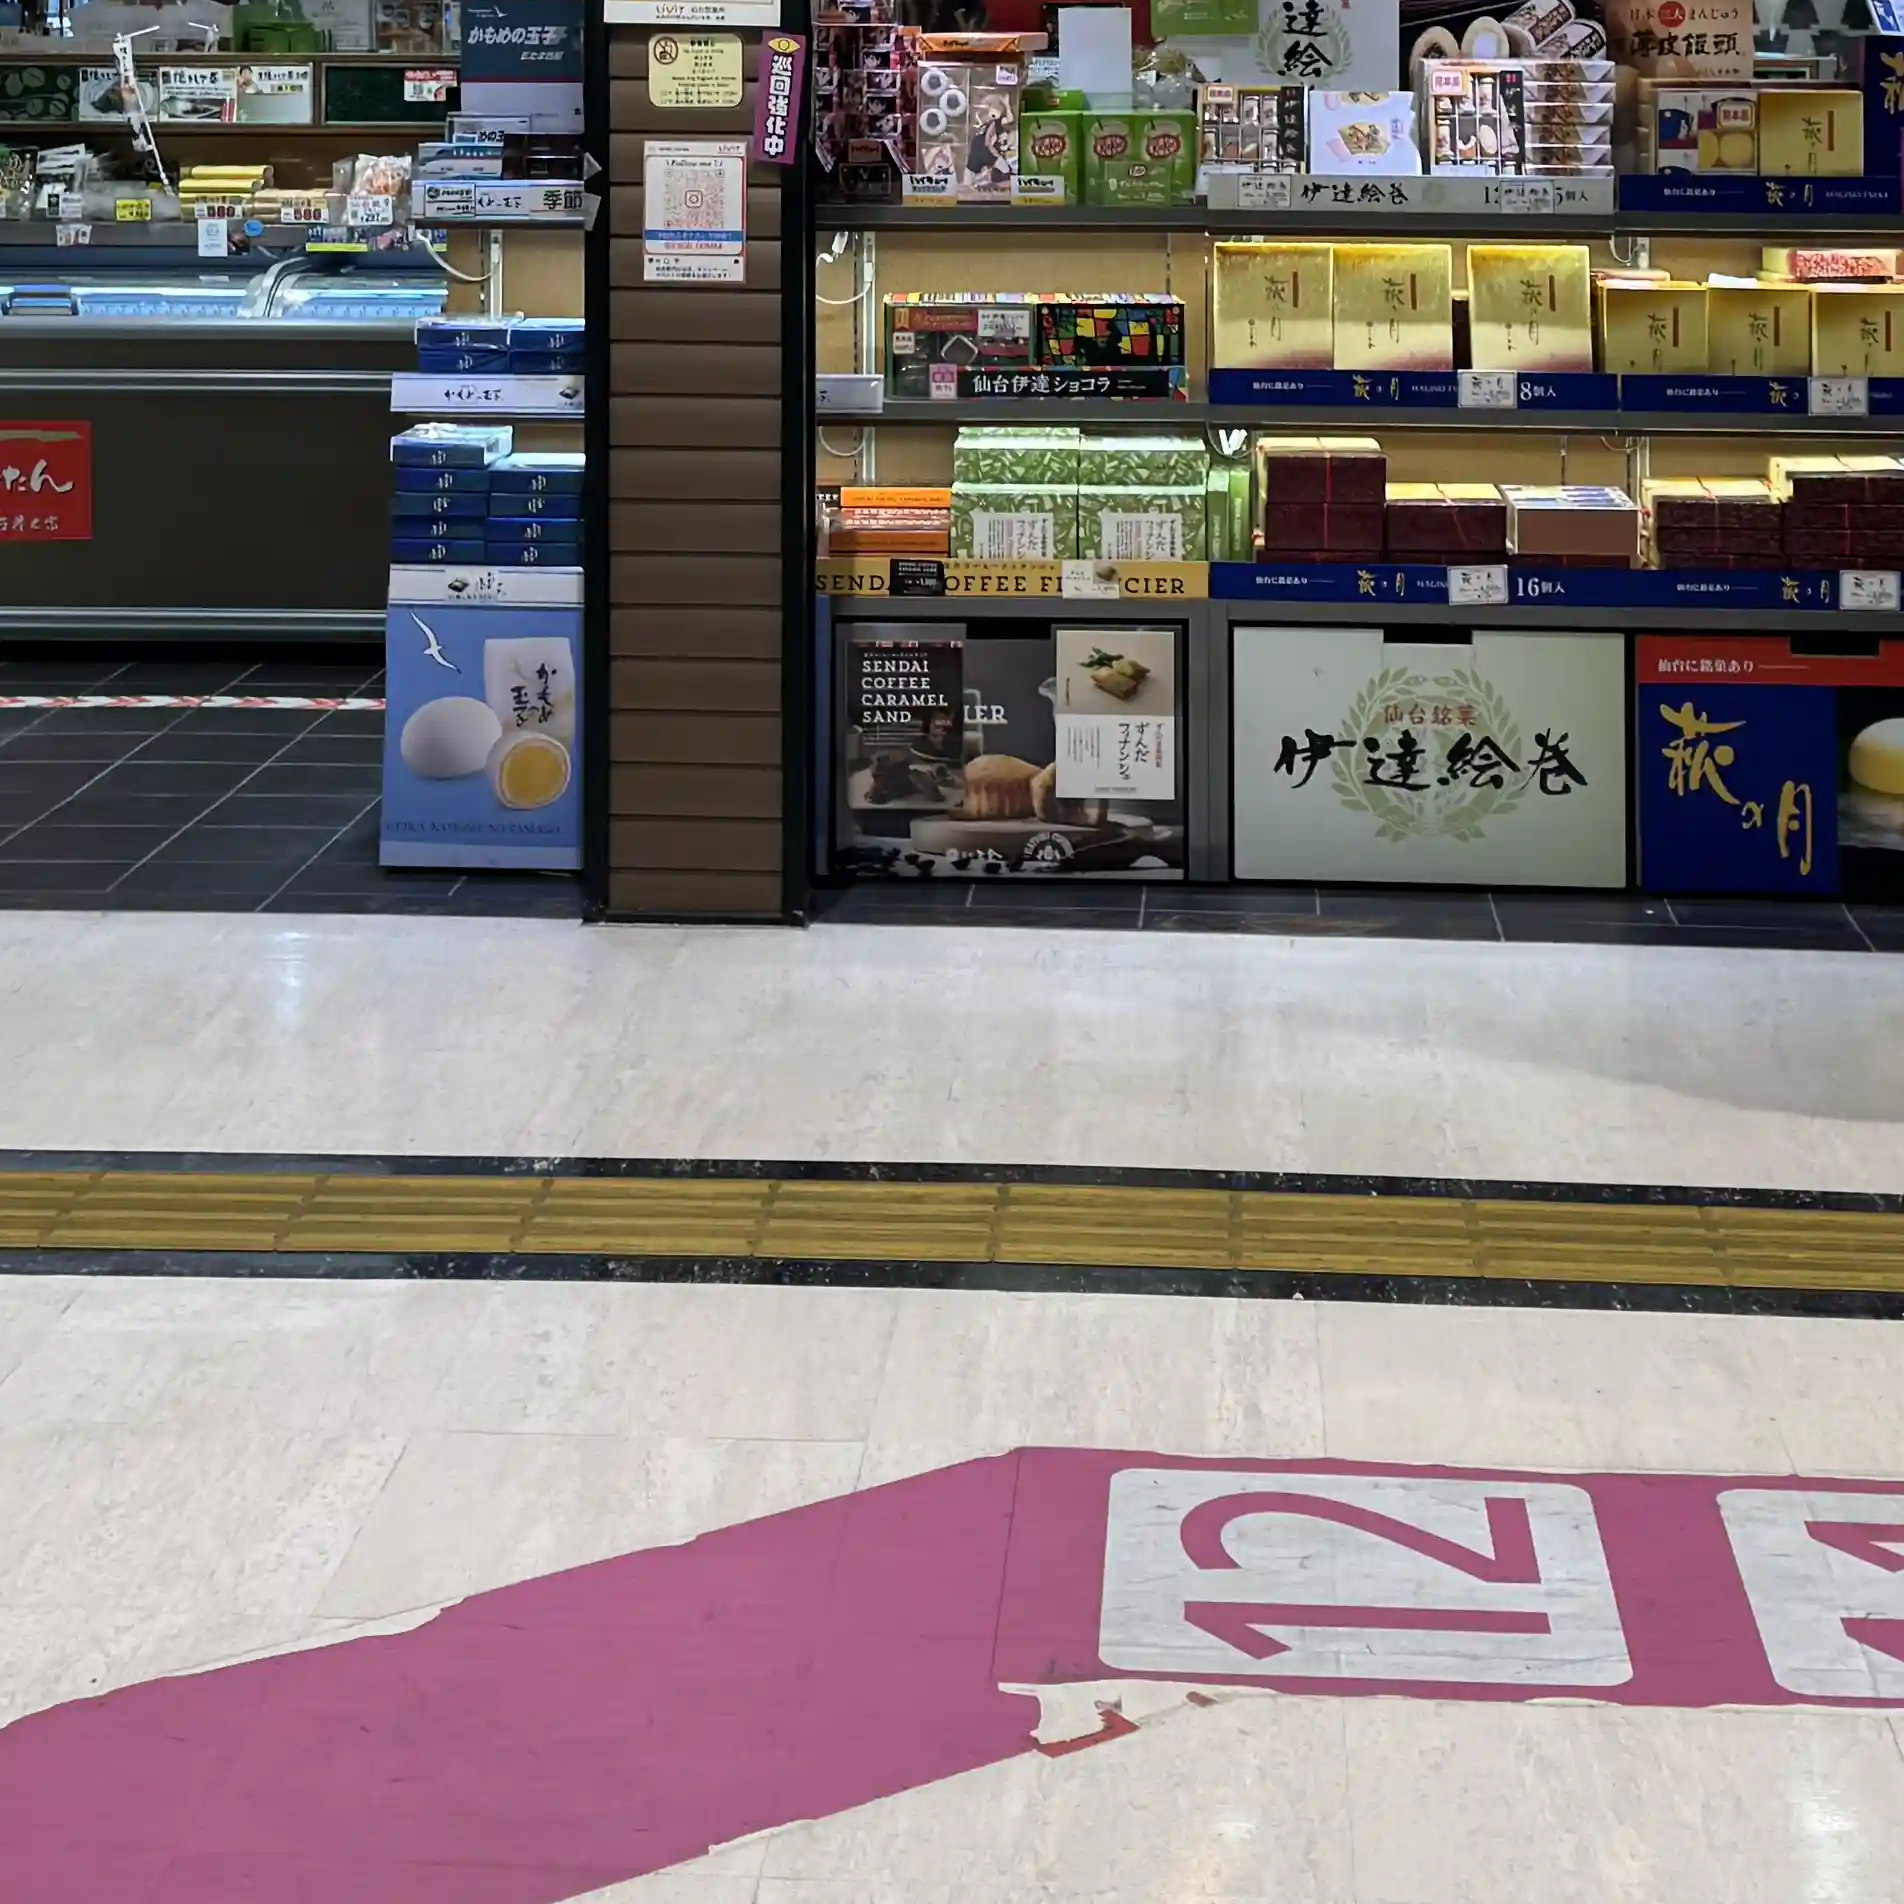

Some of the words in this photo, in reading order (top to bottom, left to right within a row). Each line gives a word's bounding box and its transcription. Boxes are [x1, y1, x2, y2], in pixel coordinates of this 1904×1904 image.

[1300, 182, 1409, 206] 伊達絵巻
[1516, 576, 1567, 598] 16個入
[861, 660, 930, 673] SENDAI
[861, 677, 931, 690] COFFEE
[861, 693, 949, 707] CARAMEL
[862, 711, 912, 724] SAND
[1273, 728, 1588, 796] 伊達絵巻
[1180, 1490, 1552, 1660] 12
